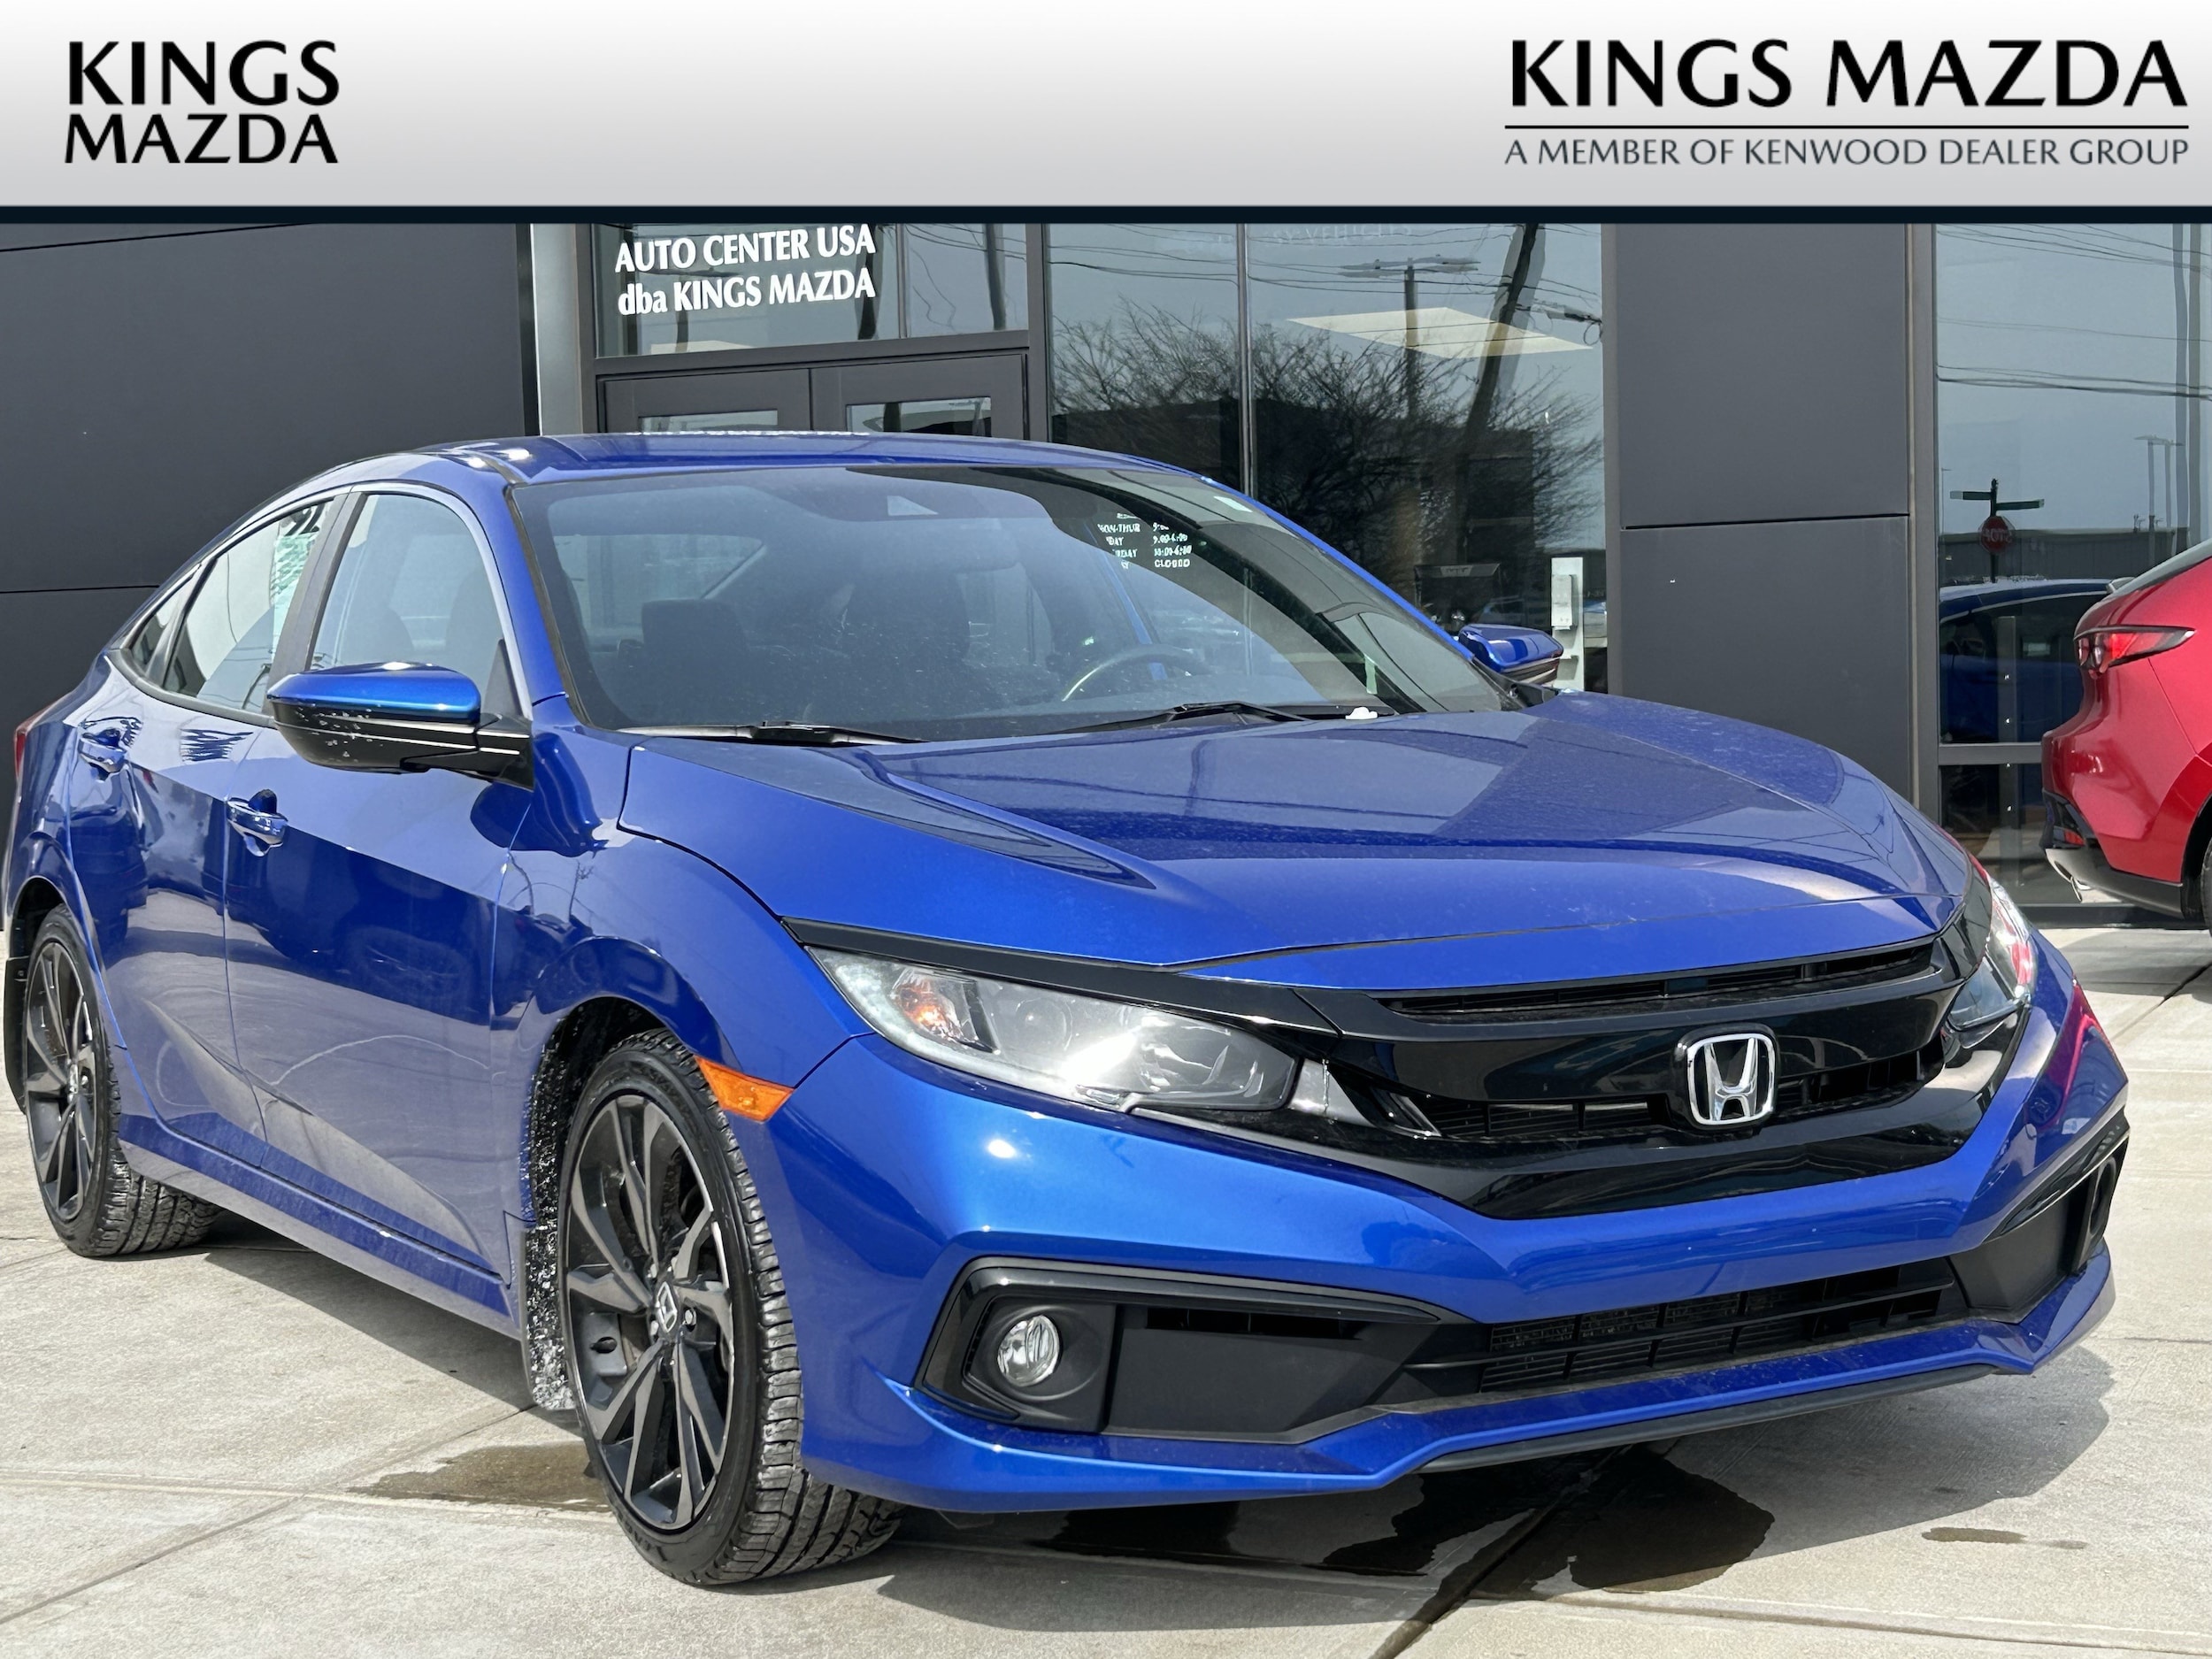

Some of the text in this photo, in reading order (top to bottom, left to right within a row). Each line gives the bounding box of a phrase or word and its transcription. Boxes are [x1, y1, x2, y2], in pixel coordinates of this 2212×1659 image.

[615, 223, 876, 273] AUTO CENTER USA
[618, 267, 876, 316] dba KINGS MAZDA
